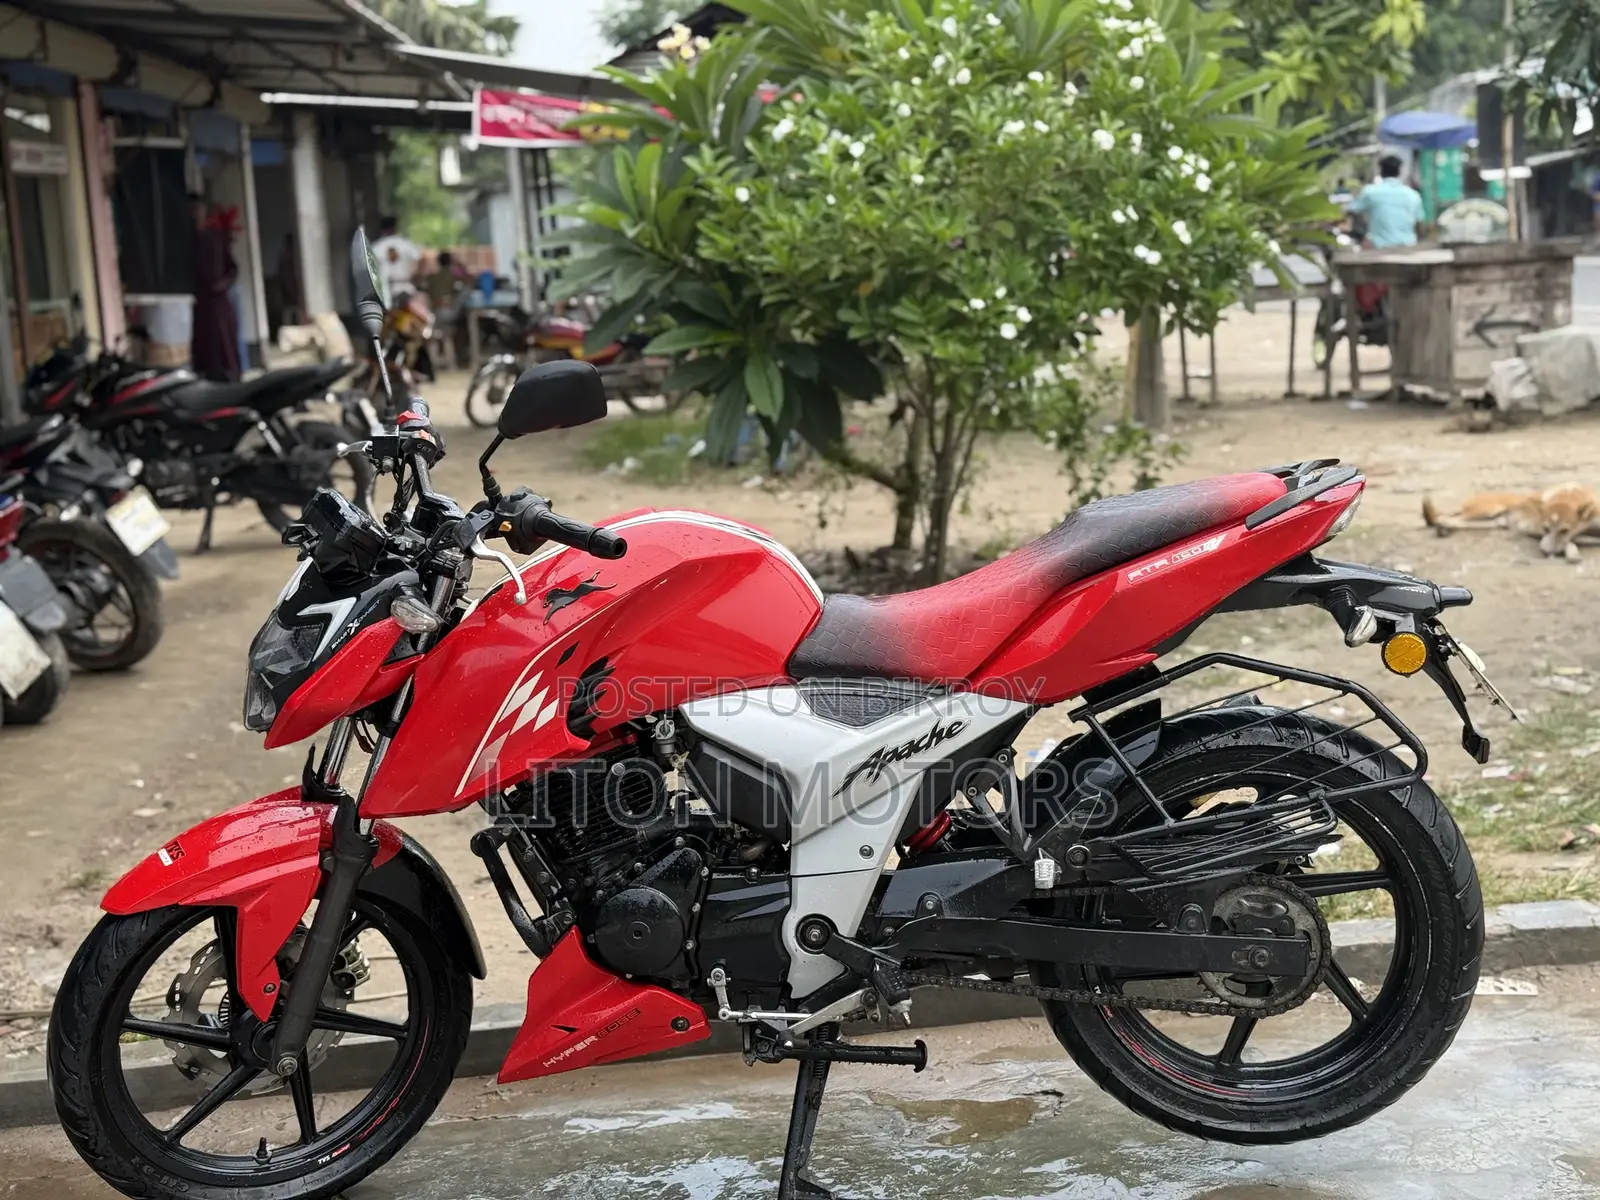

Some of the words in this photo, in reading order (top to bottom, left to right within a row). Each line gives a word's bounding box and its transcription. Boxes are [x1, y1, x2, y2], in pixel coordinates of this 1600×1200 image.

[1127, 558, 1169, 581] RTR
[831, 718, 970, 799] Apache
[543, 1035, 598, 1068] HYPER
